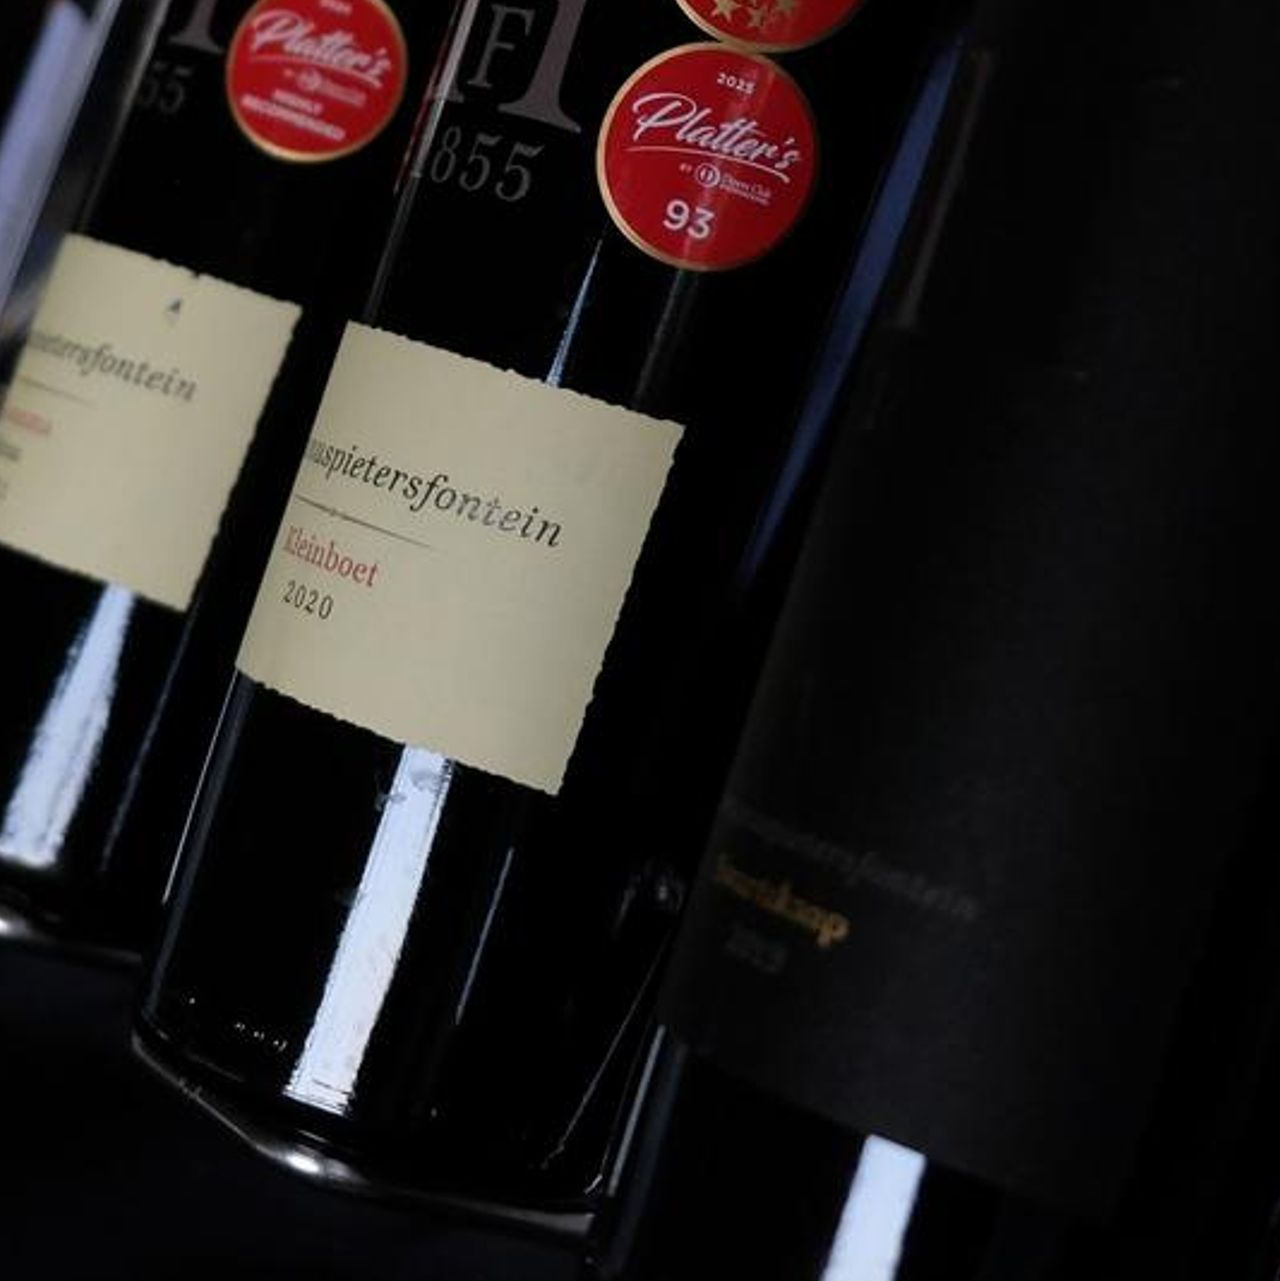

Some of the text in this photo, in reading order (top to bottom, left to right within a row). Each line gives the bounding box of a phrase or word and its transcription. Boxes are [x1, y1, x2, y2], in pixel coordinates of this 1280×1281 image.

[465, 2, 538, 88] F
[632, 92, 803, 170] Platter's
[663, 198, 715, 240] 93
[283, 579, 336, 620] 2020
